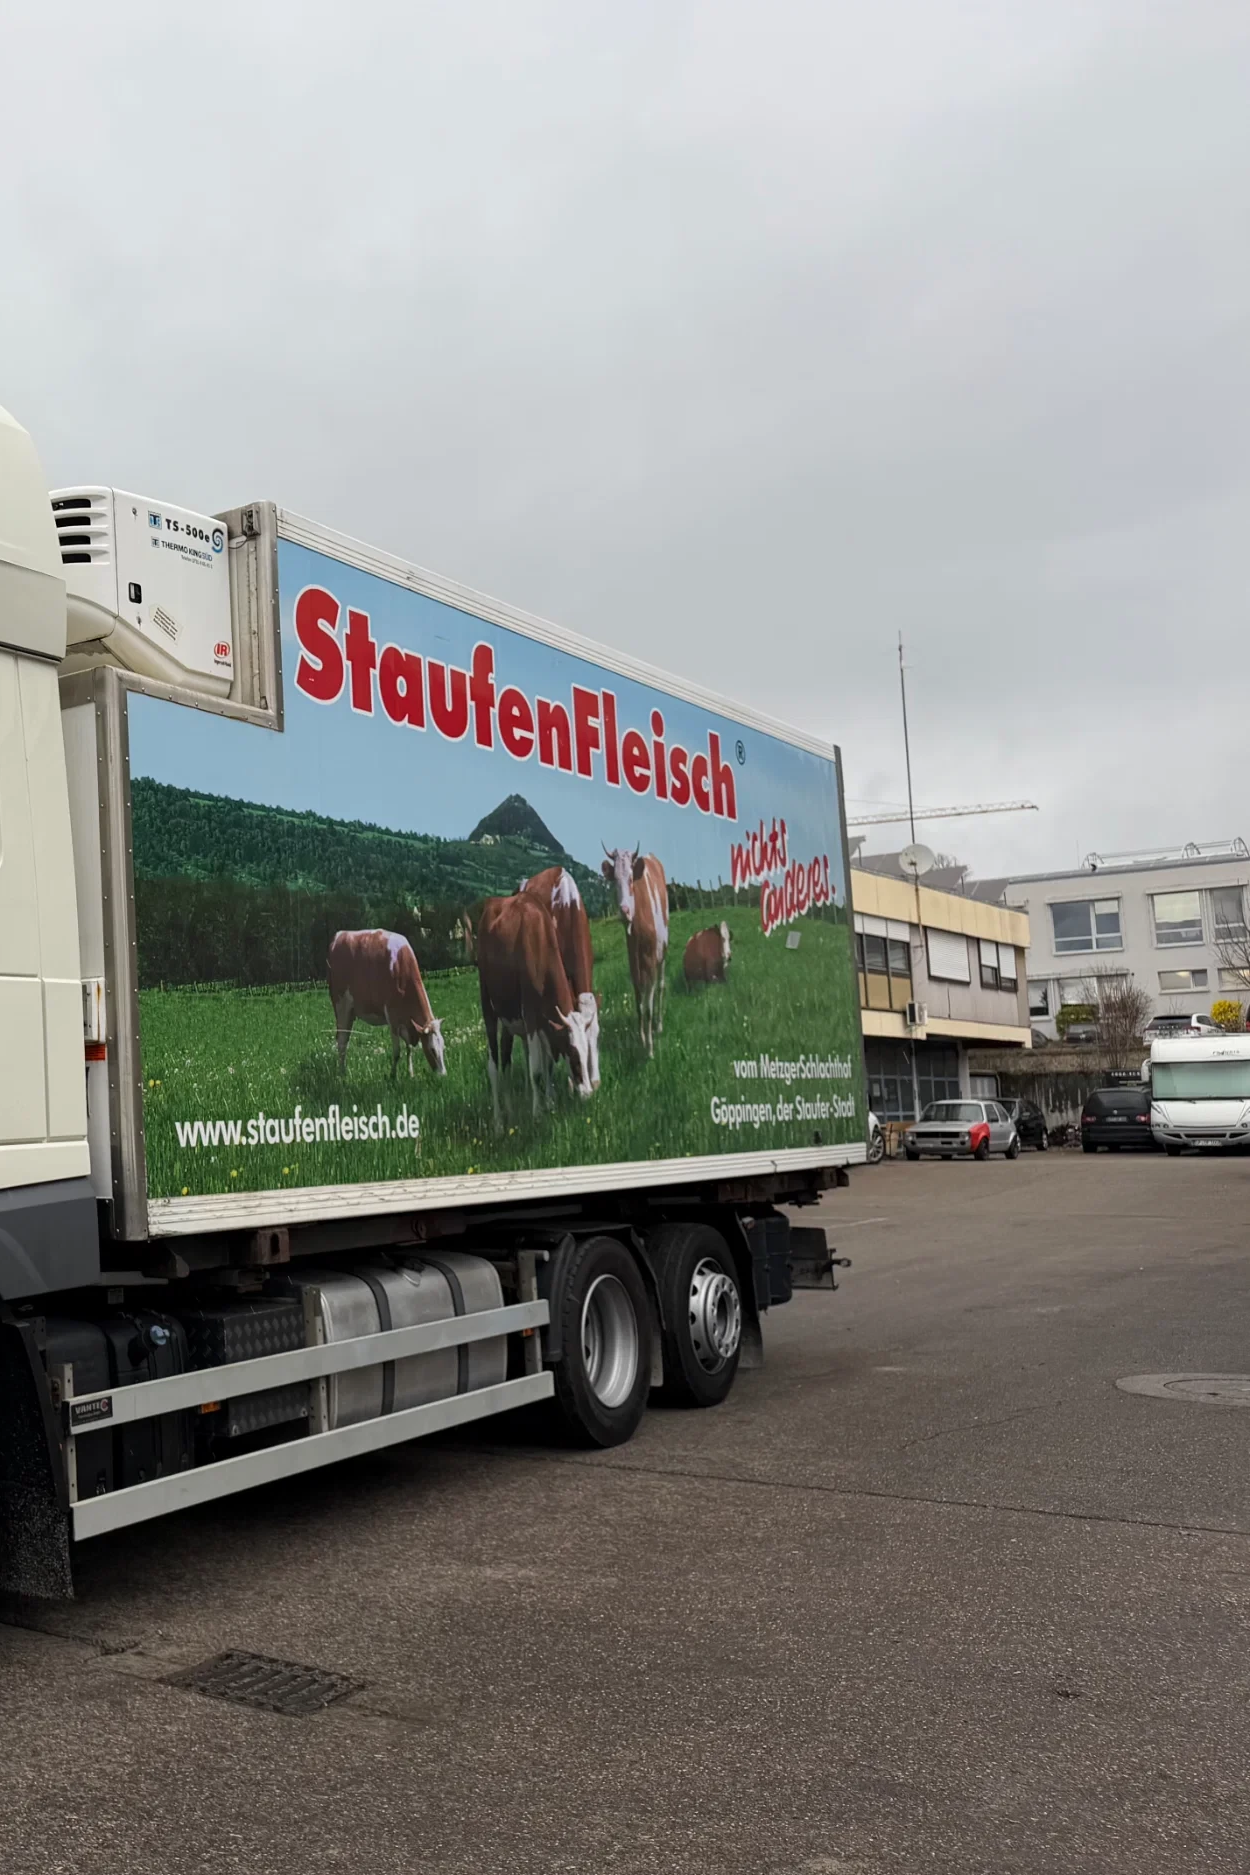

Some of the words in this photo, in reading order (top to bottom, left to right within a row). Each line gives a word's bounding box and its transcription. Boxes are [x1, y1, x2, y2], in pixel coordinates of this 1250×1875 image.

[161, 540, 188, 554] THERMO
[165, 518, 210, 543] TS-500e
[293, 584, 738, 821] StaufenFleisch
[730, 817, 787, 891] nichts
[761, 854, 836, 935] anderes.
[733, 1057, 759, 1079] vom
[760, 1053, 852, 1086] MetzgerSchlachthof
[174, 1103, 420, 1148] www.staufenfleisch.de
[710, 1095, 776, 1130] Göppingen,
[776, 1093, 794, 1121] der
[795, 1092, 856, 1121] Staufer-Stadt
